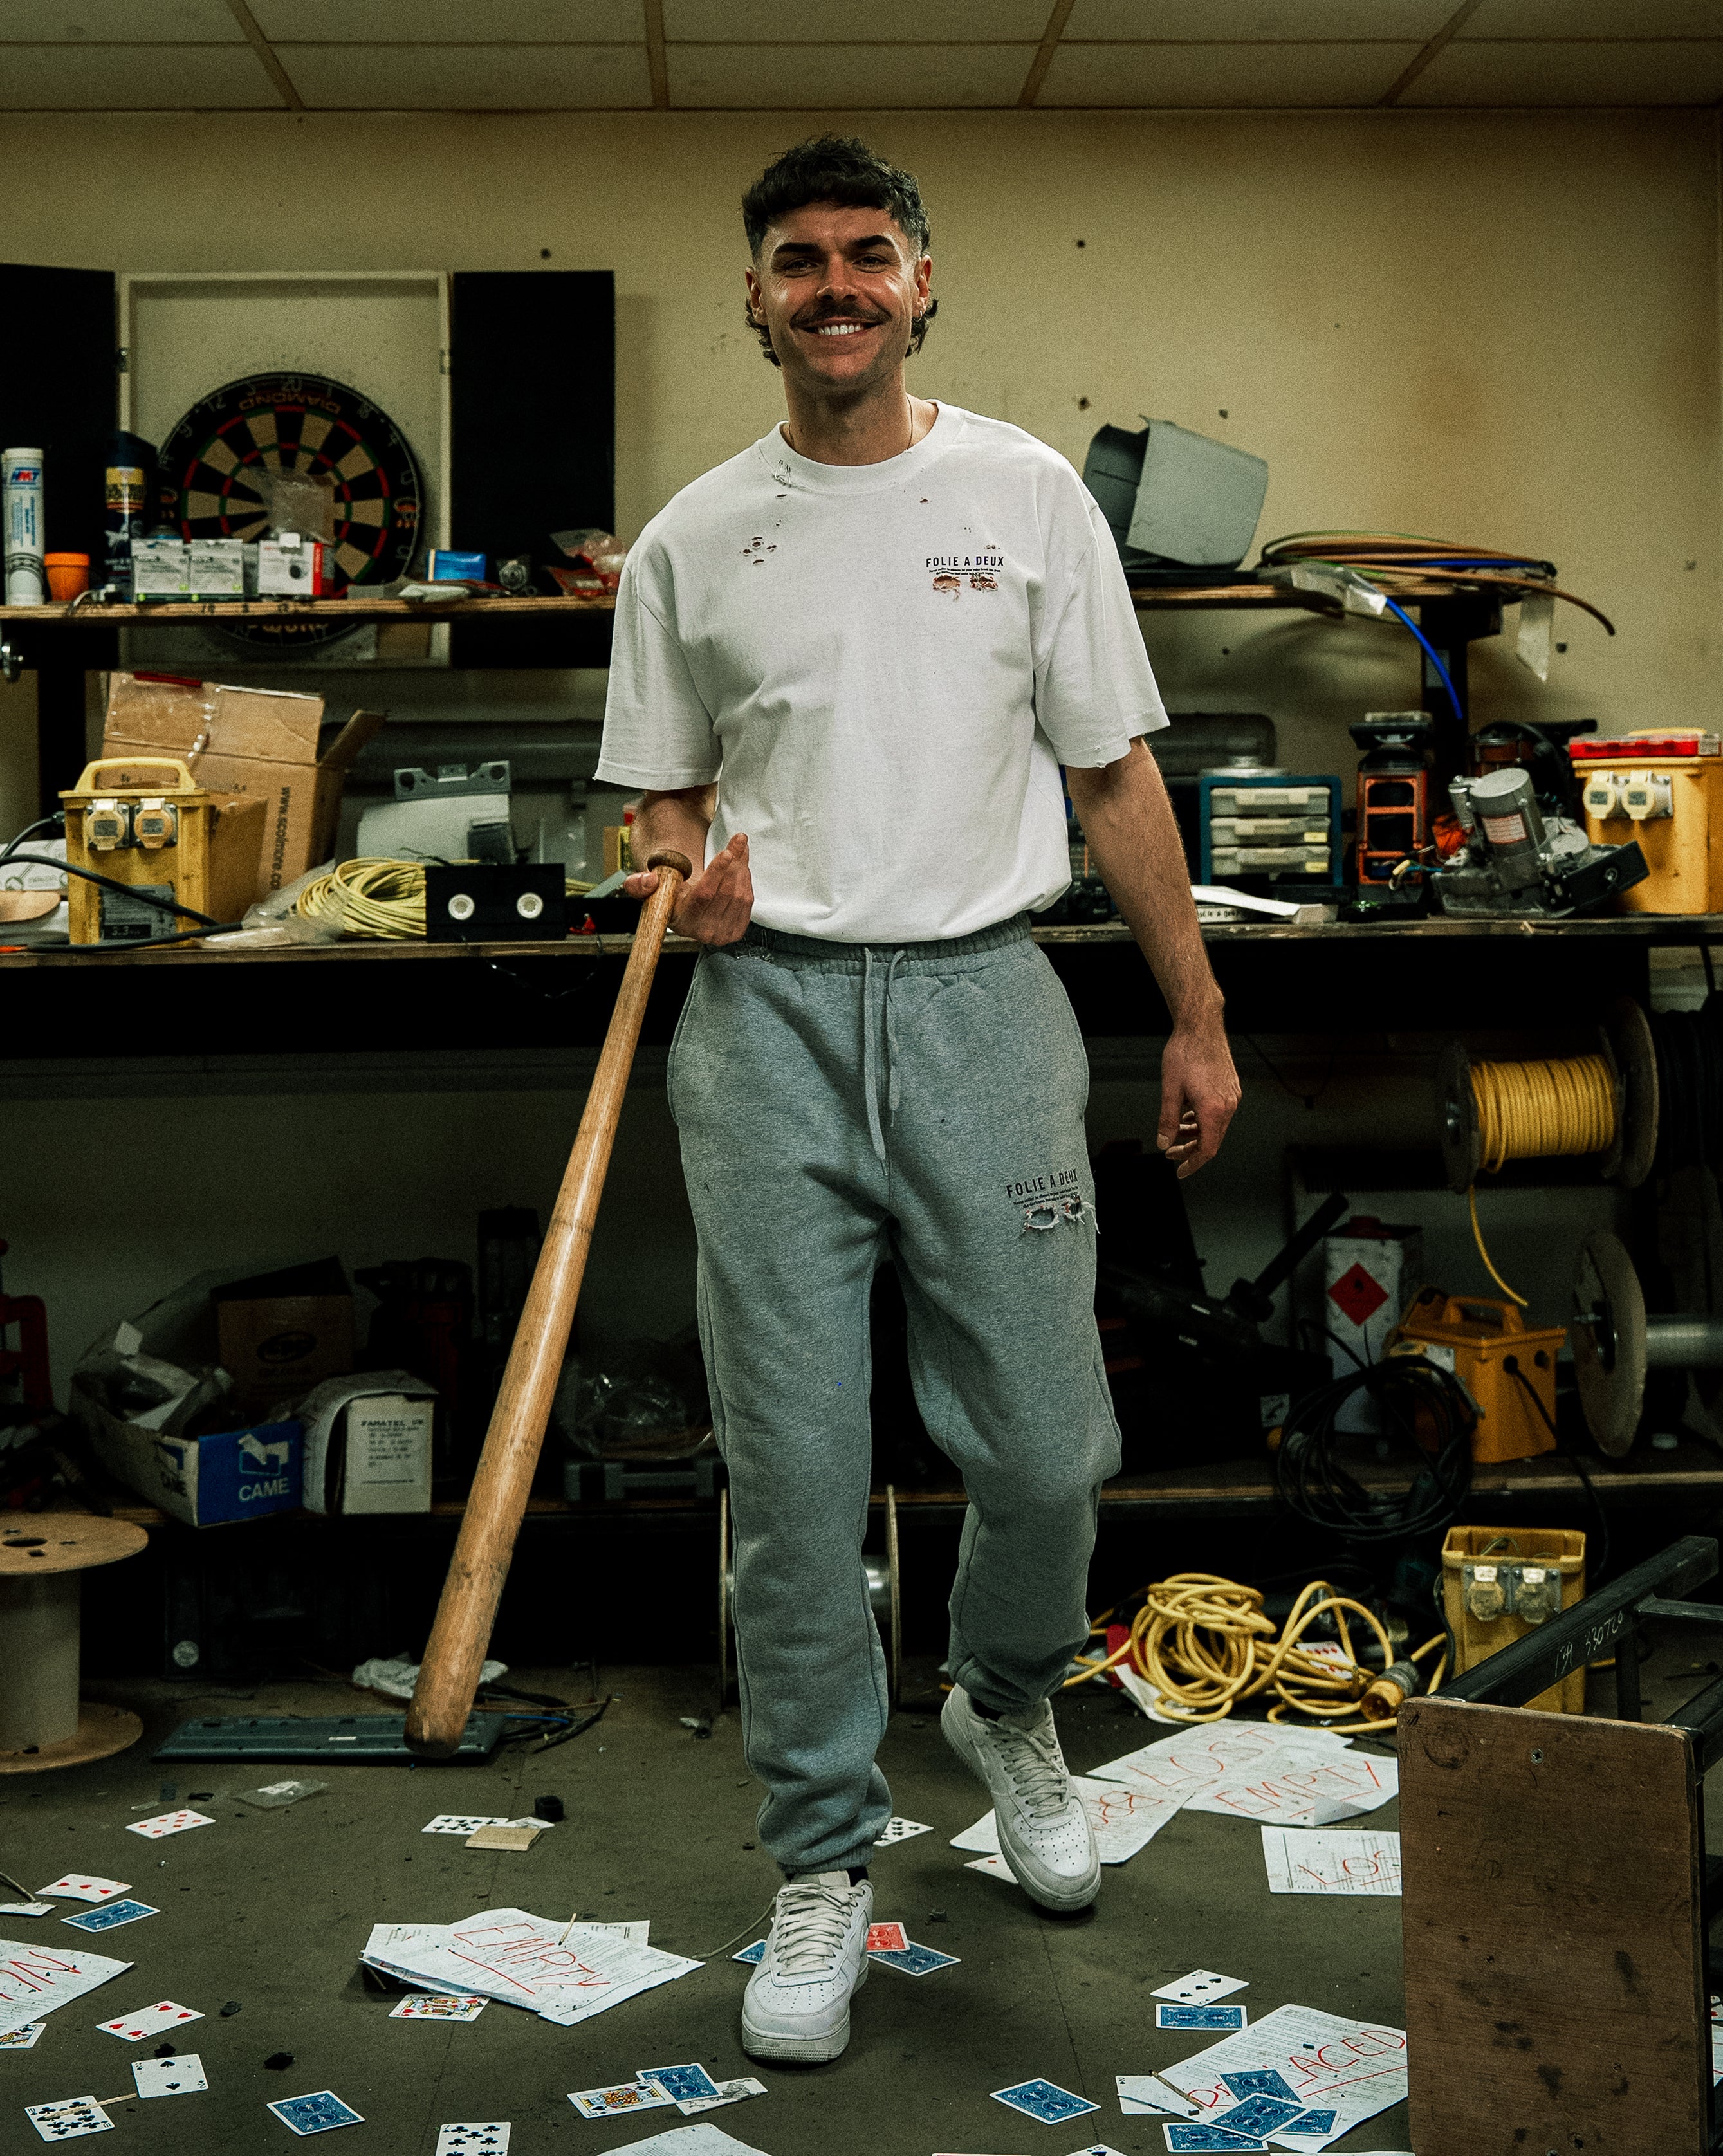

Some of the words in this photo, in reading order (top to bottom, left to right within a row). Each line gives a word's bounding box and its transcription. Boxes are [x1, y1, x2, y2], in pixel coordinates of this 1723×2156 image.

[926, 557, 959, 568] FOLIE
[964, 556, 970, 566] A
[976, 555, 1004, 567] DEUX
[1006, 1177, 1046, 1199] FOLIE
[1049, 1175, 1056, 1188] A
[1058, 1168, 1078, 1186] DEUX
[239, 1477, 290, 1501] CAME
[1126, 1727, 1275, 1787] LOST
[1214, 1760, 1381, 1814] EMPTY
[453, 1922, 611, 1987] EMPTY
